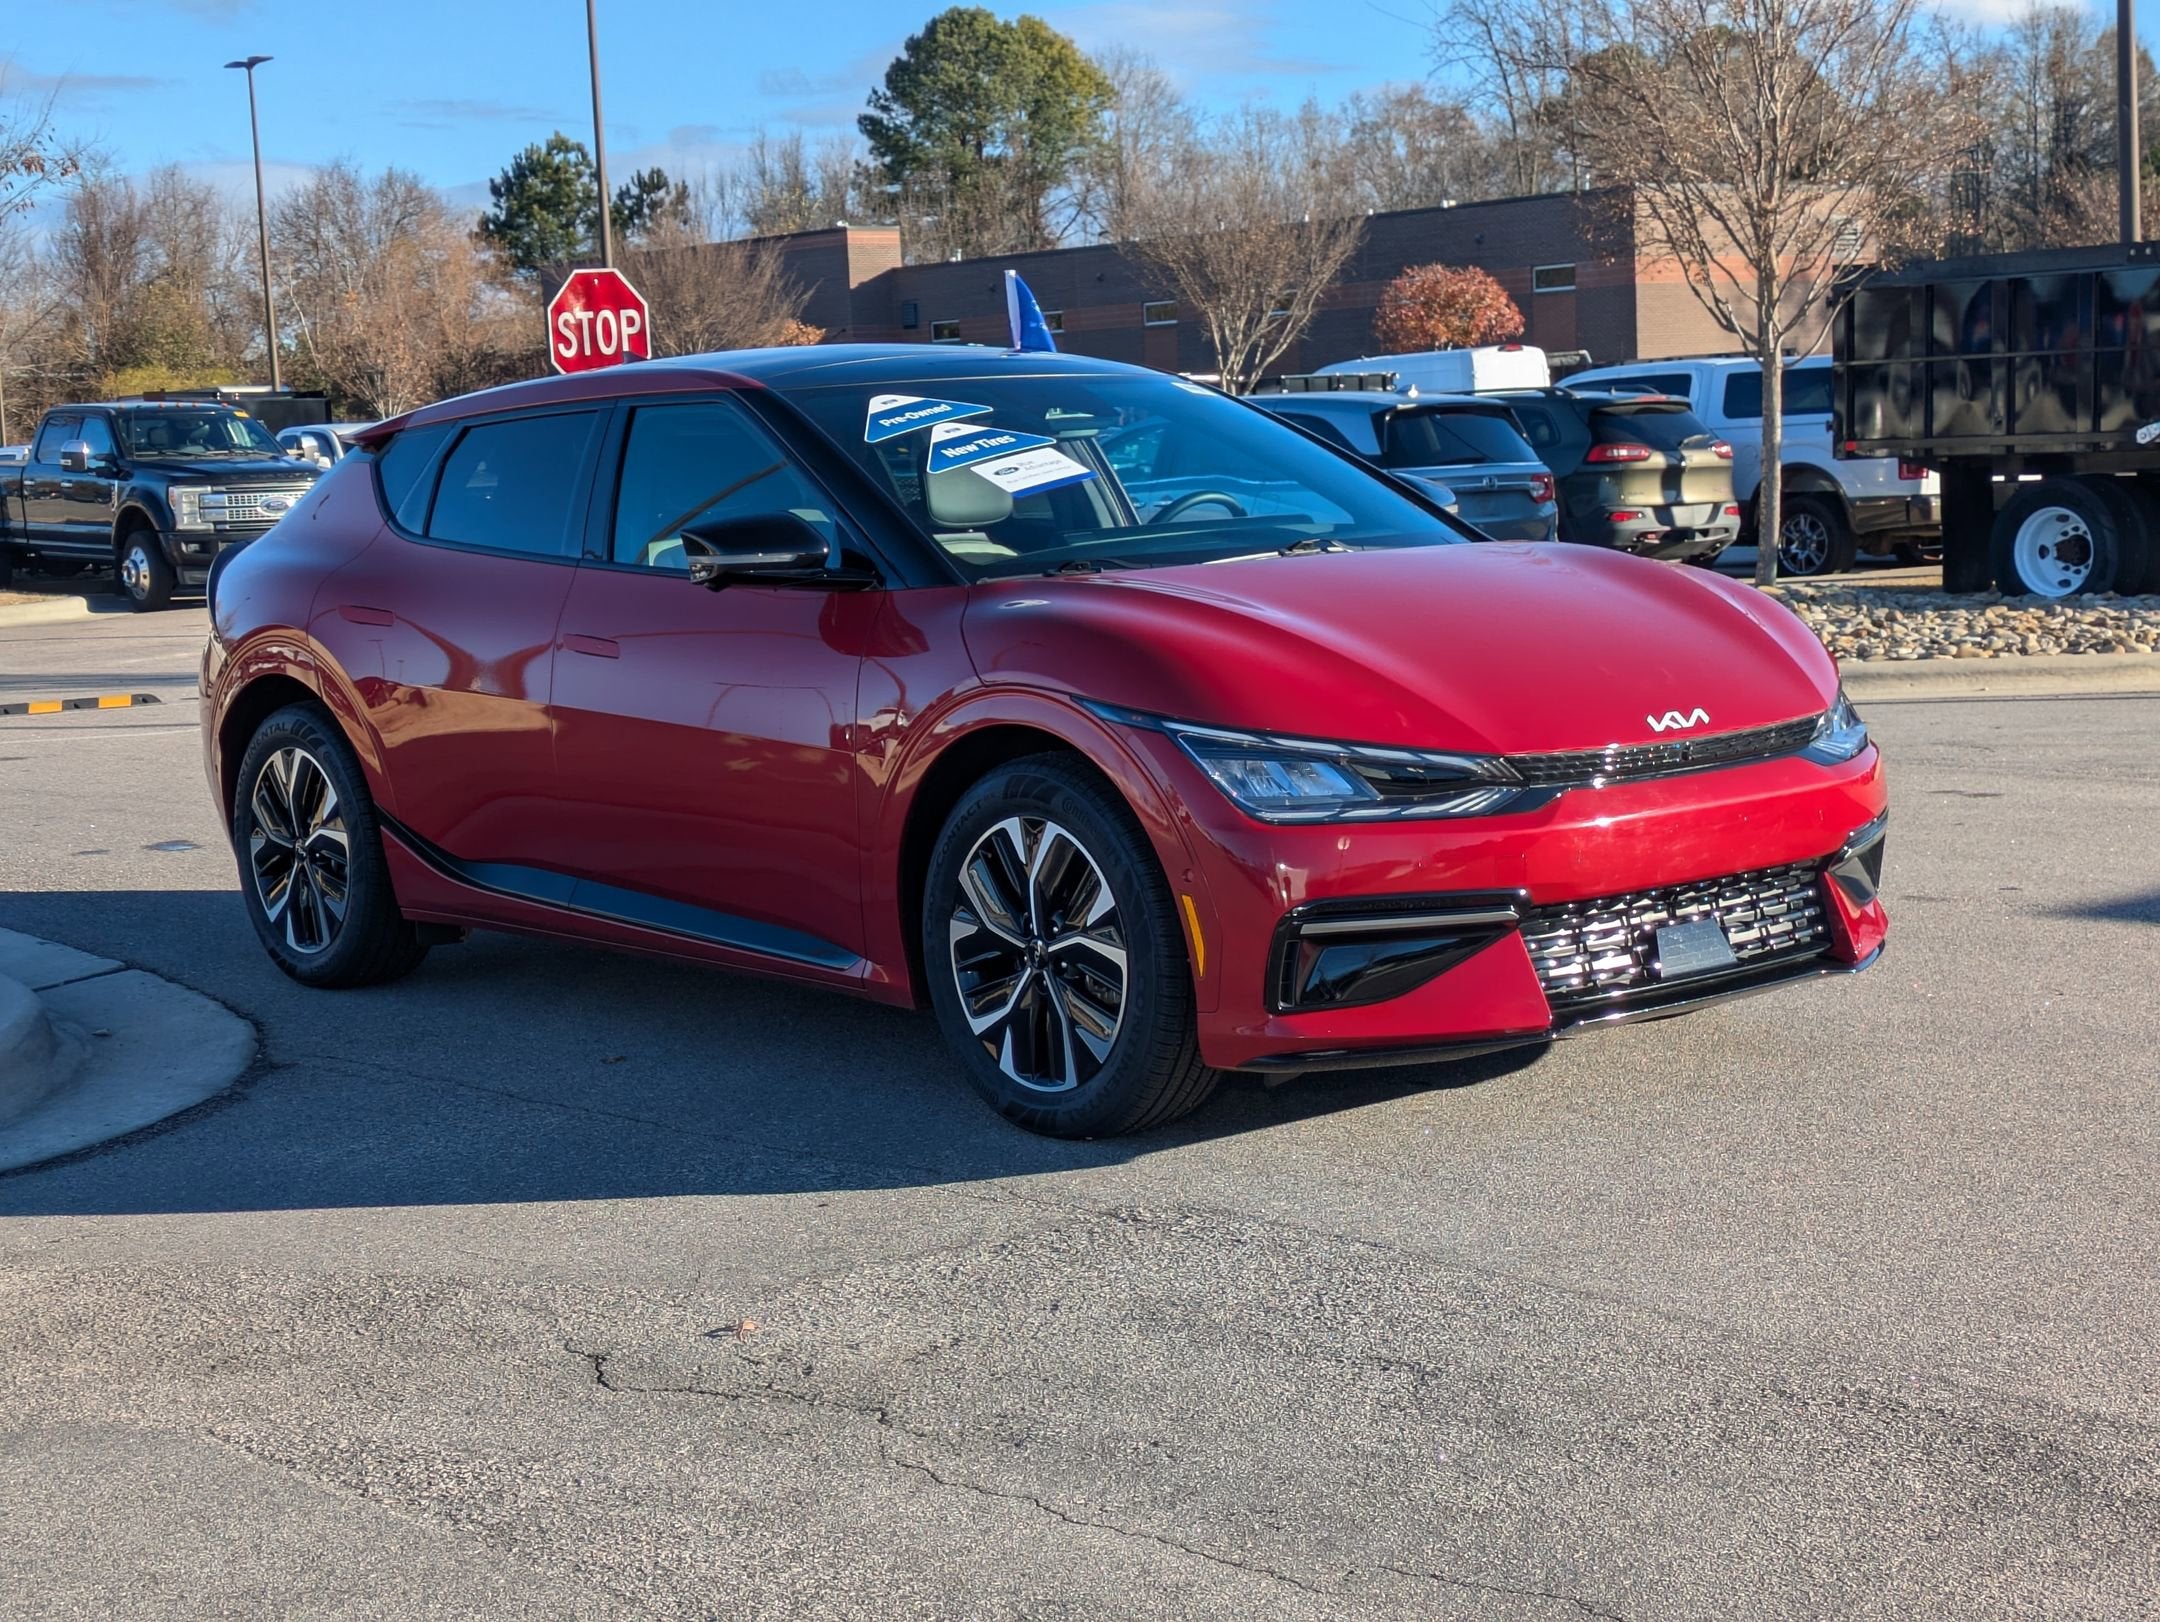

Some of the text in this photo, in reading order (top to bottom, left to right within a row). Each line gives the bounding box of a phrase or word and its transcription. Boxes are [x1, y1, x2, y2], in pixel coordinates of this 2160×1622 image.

[558, 308, 641, 358] STOP
[878, 403, 953, 427] Pre-Owned
[940, 434, 1017, 459] New Tires
